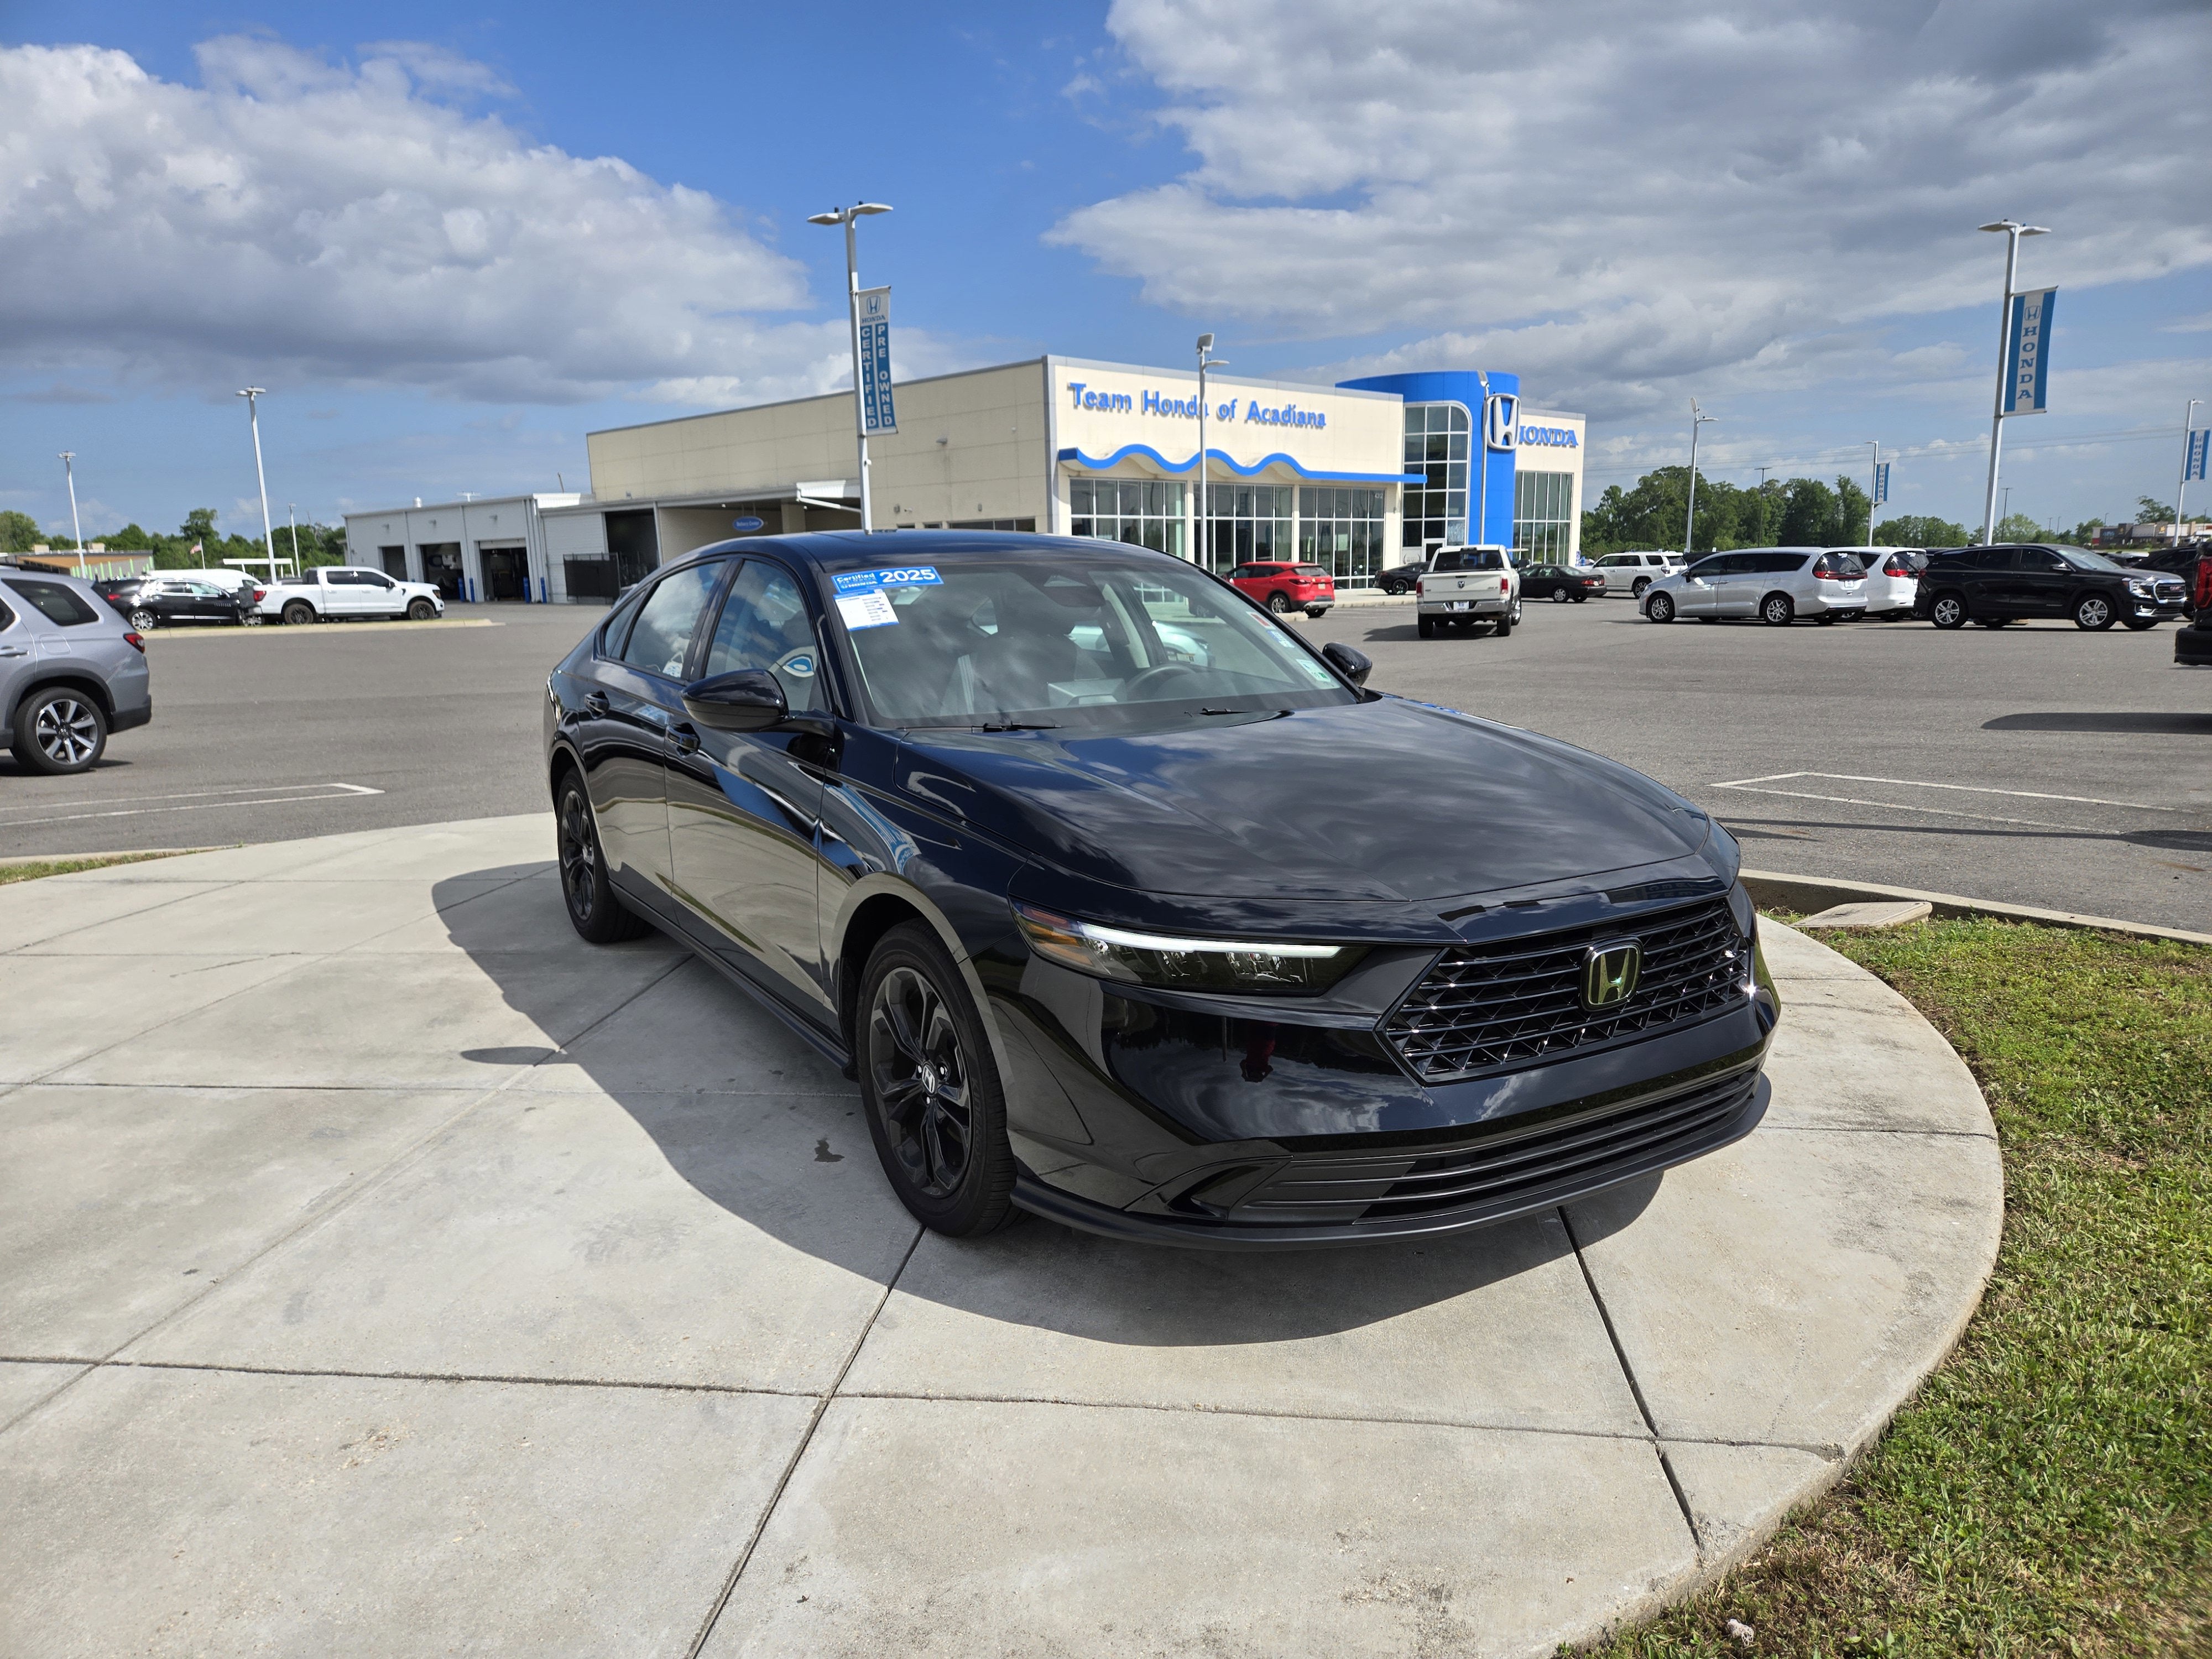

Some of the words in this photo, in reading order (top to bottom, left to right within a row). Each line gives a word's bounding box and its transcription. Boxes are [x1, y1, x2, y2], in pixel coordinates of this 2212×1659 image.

[878, 325, 886, 358] PRE
[2017, 326, 2038, 399] HONDA
[861, 327, 877, 427] CERTIFIED
[879, 371, 893, 425] OWNED
[1069, 382, 1132, 410] Team
[1218, 398, 1238, 419] of
[1246, 400, 1326, 427] Acadiana
[2192, 444, 2201, 476] HONDA
[837, 572, 875, 582] Certified
[880, 568, 936, 583] 2025
[972, 1078, 983, 1160] KINERGY
